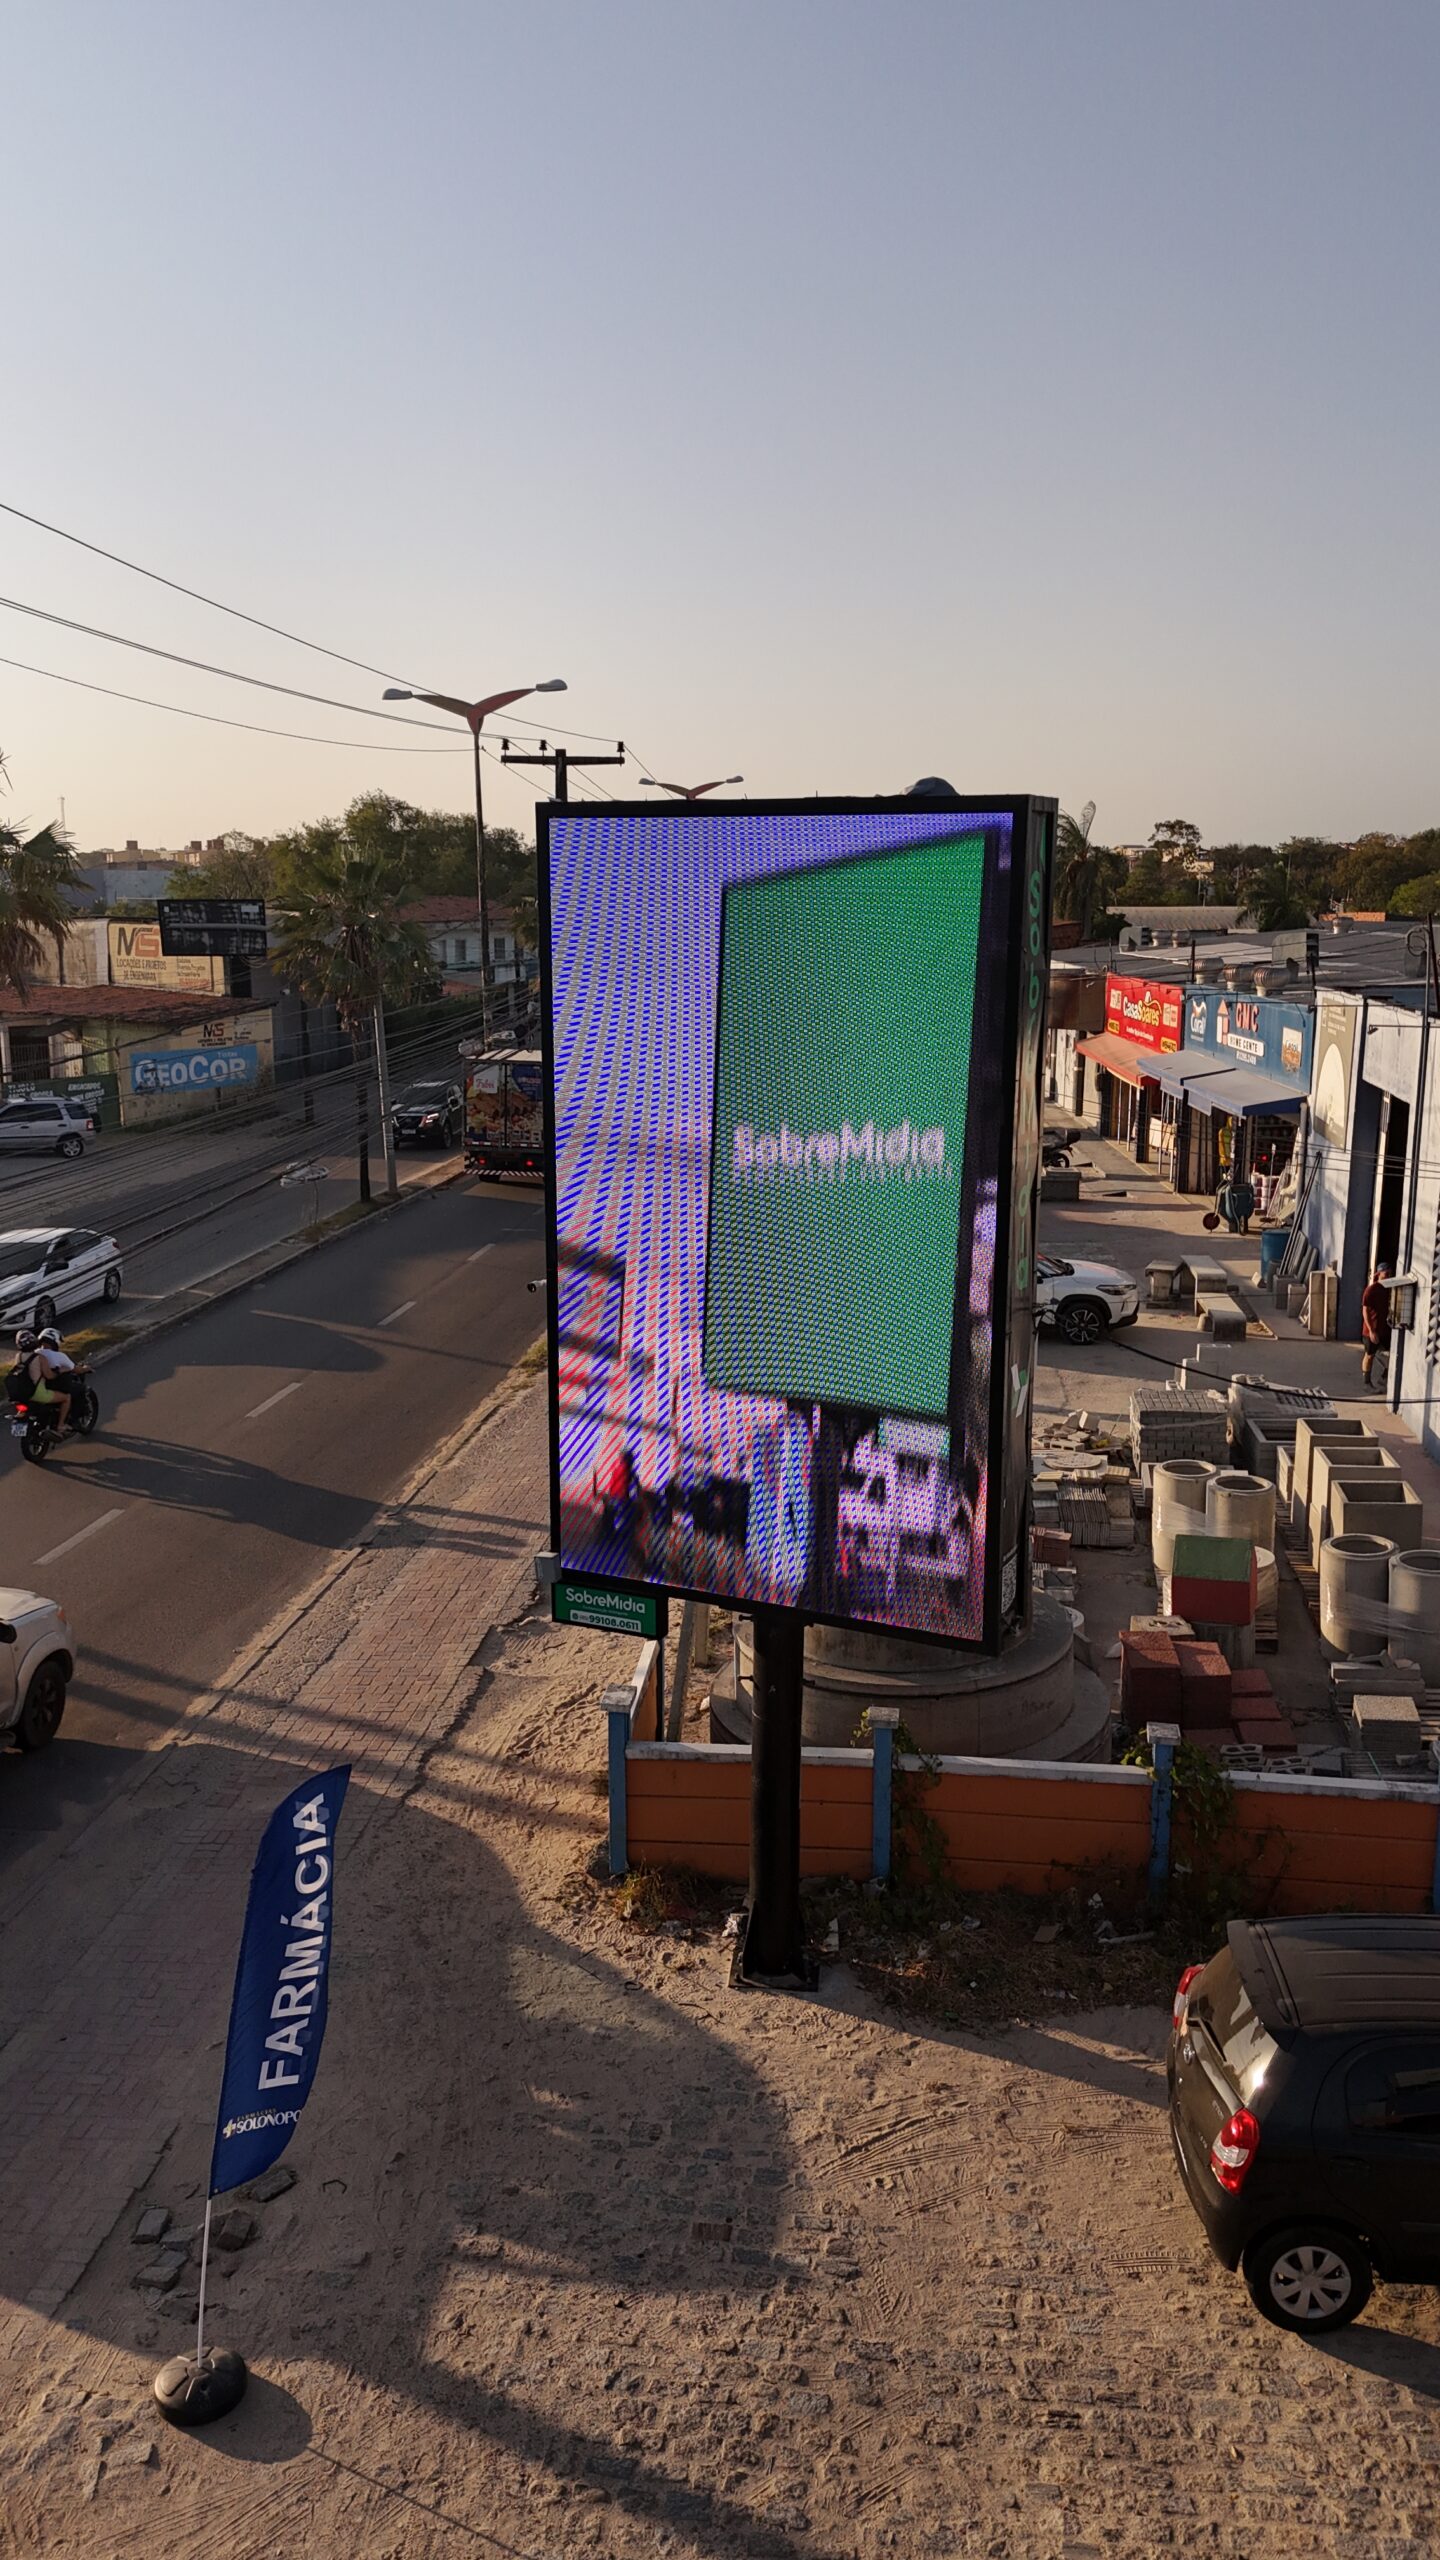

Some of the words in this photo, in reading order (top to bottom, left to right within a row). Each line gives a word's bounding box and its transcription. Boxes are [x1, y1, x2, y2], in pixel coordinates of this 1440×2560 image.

[1236, 1002, 1260, 1032] GMC
[1243, 1039, 1260, 1053] CENTE
[565, 1587, 646, 1614] SobreMidia
[588, 1614, 639, 1631] 99108.0611
[258, 1793, 330, 2090] FARMÁCIA
